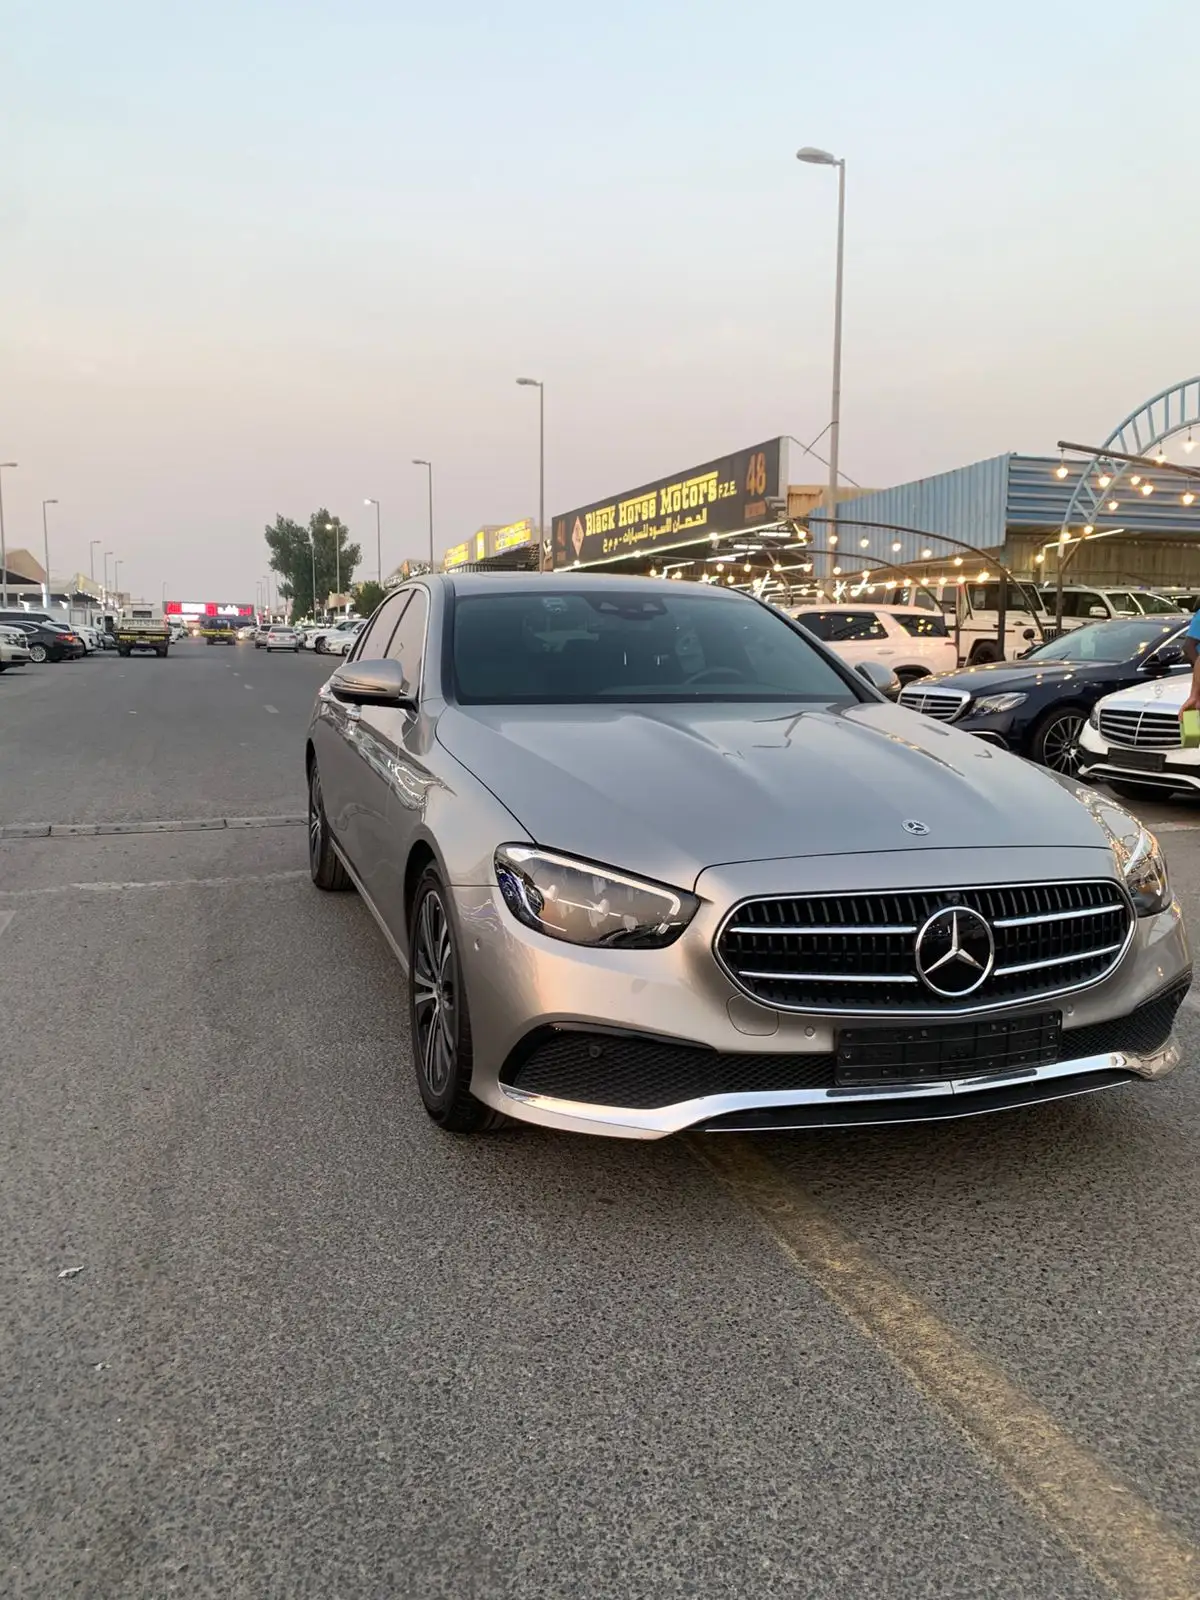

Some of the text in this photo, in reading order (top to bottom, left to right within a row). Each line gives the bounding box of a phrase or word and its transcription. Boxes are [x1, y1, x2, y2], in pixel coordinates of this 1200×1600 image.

[746, 453, 767, 497] 48
[585, 505, 616, 537] Black
[618, 491, 657, 528] Horse
[660, 471, 719, 516] Motors
